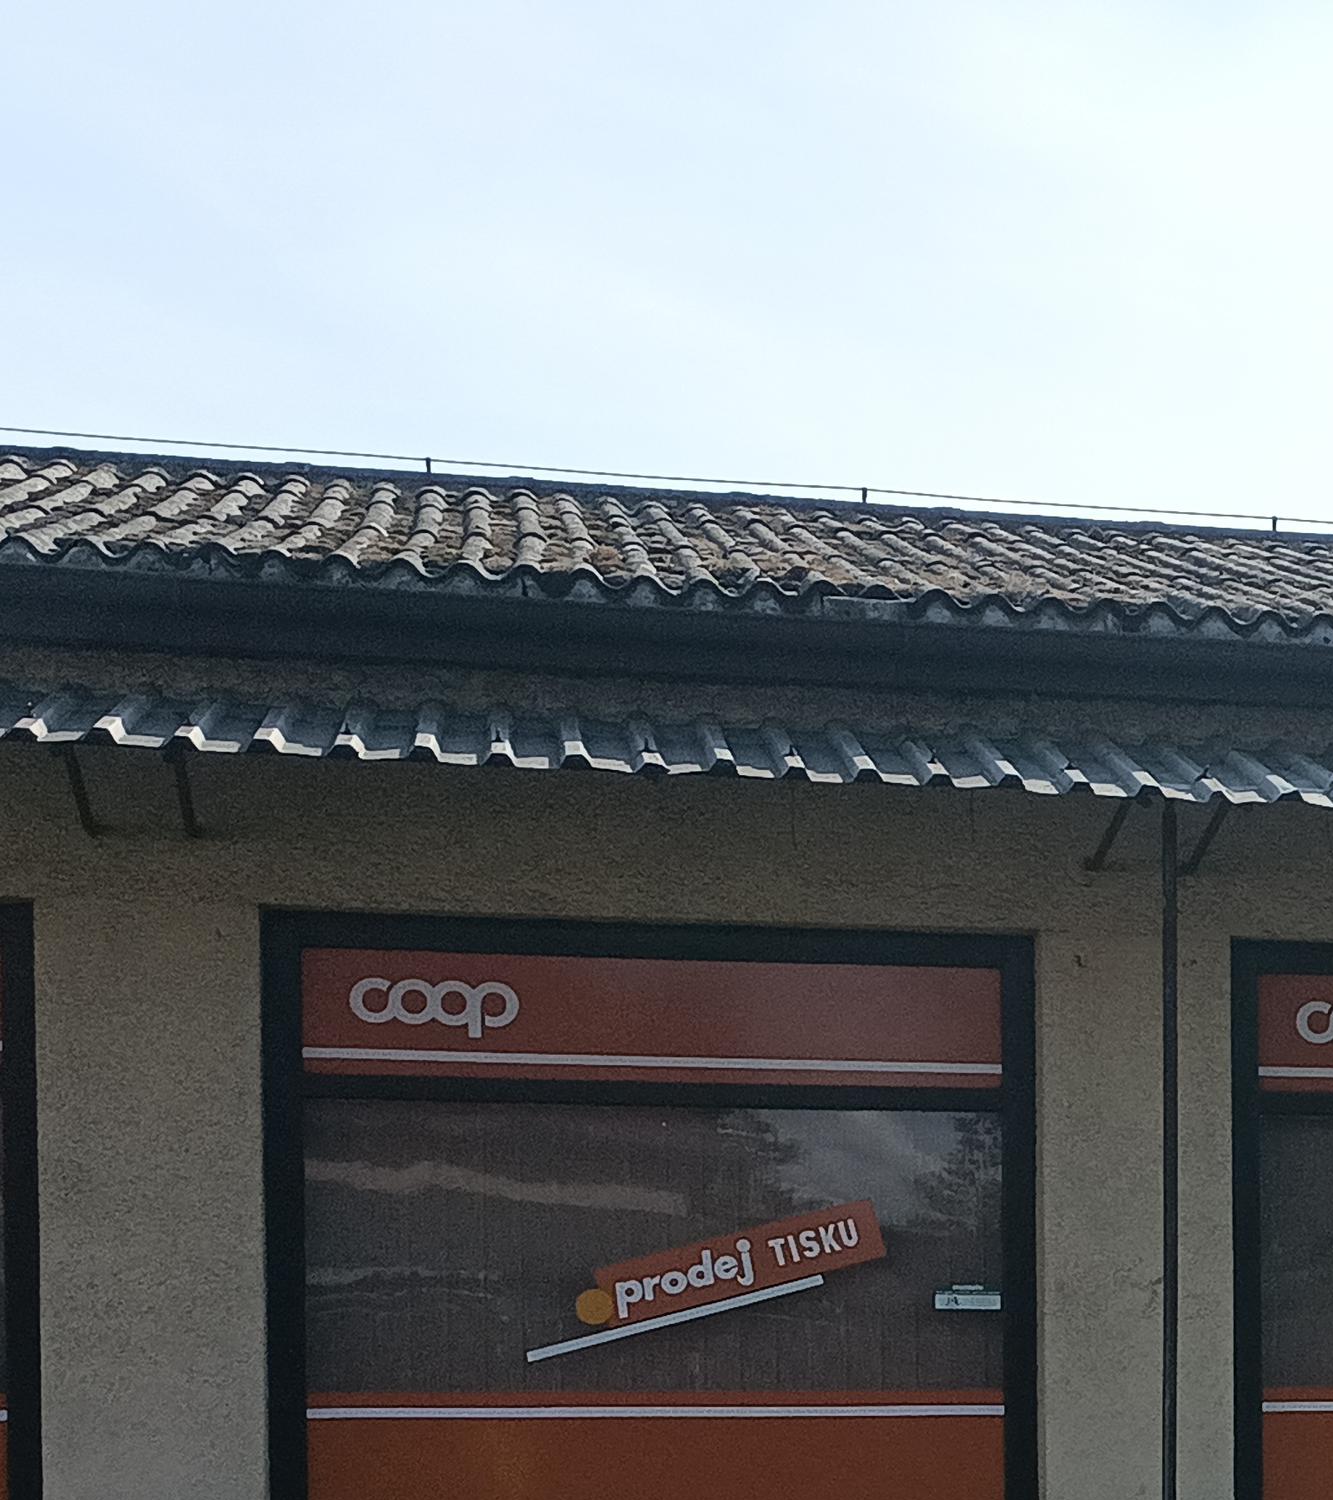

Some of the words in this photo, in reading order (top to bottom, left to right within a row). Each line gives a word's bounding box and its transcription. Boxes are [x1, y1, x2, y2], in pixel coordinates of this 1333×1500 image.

[349, 977, 519, 1038] coop
[615, 1238, 755, 1320] prodej
[768, 1218, 859, 1267] TISKU
